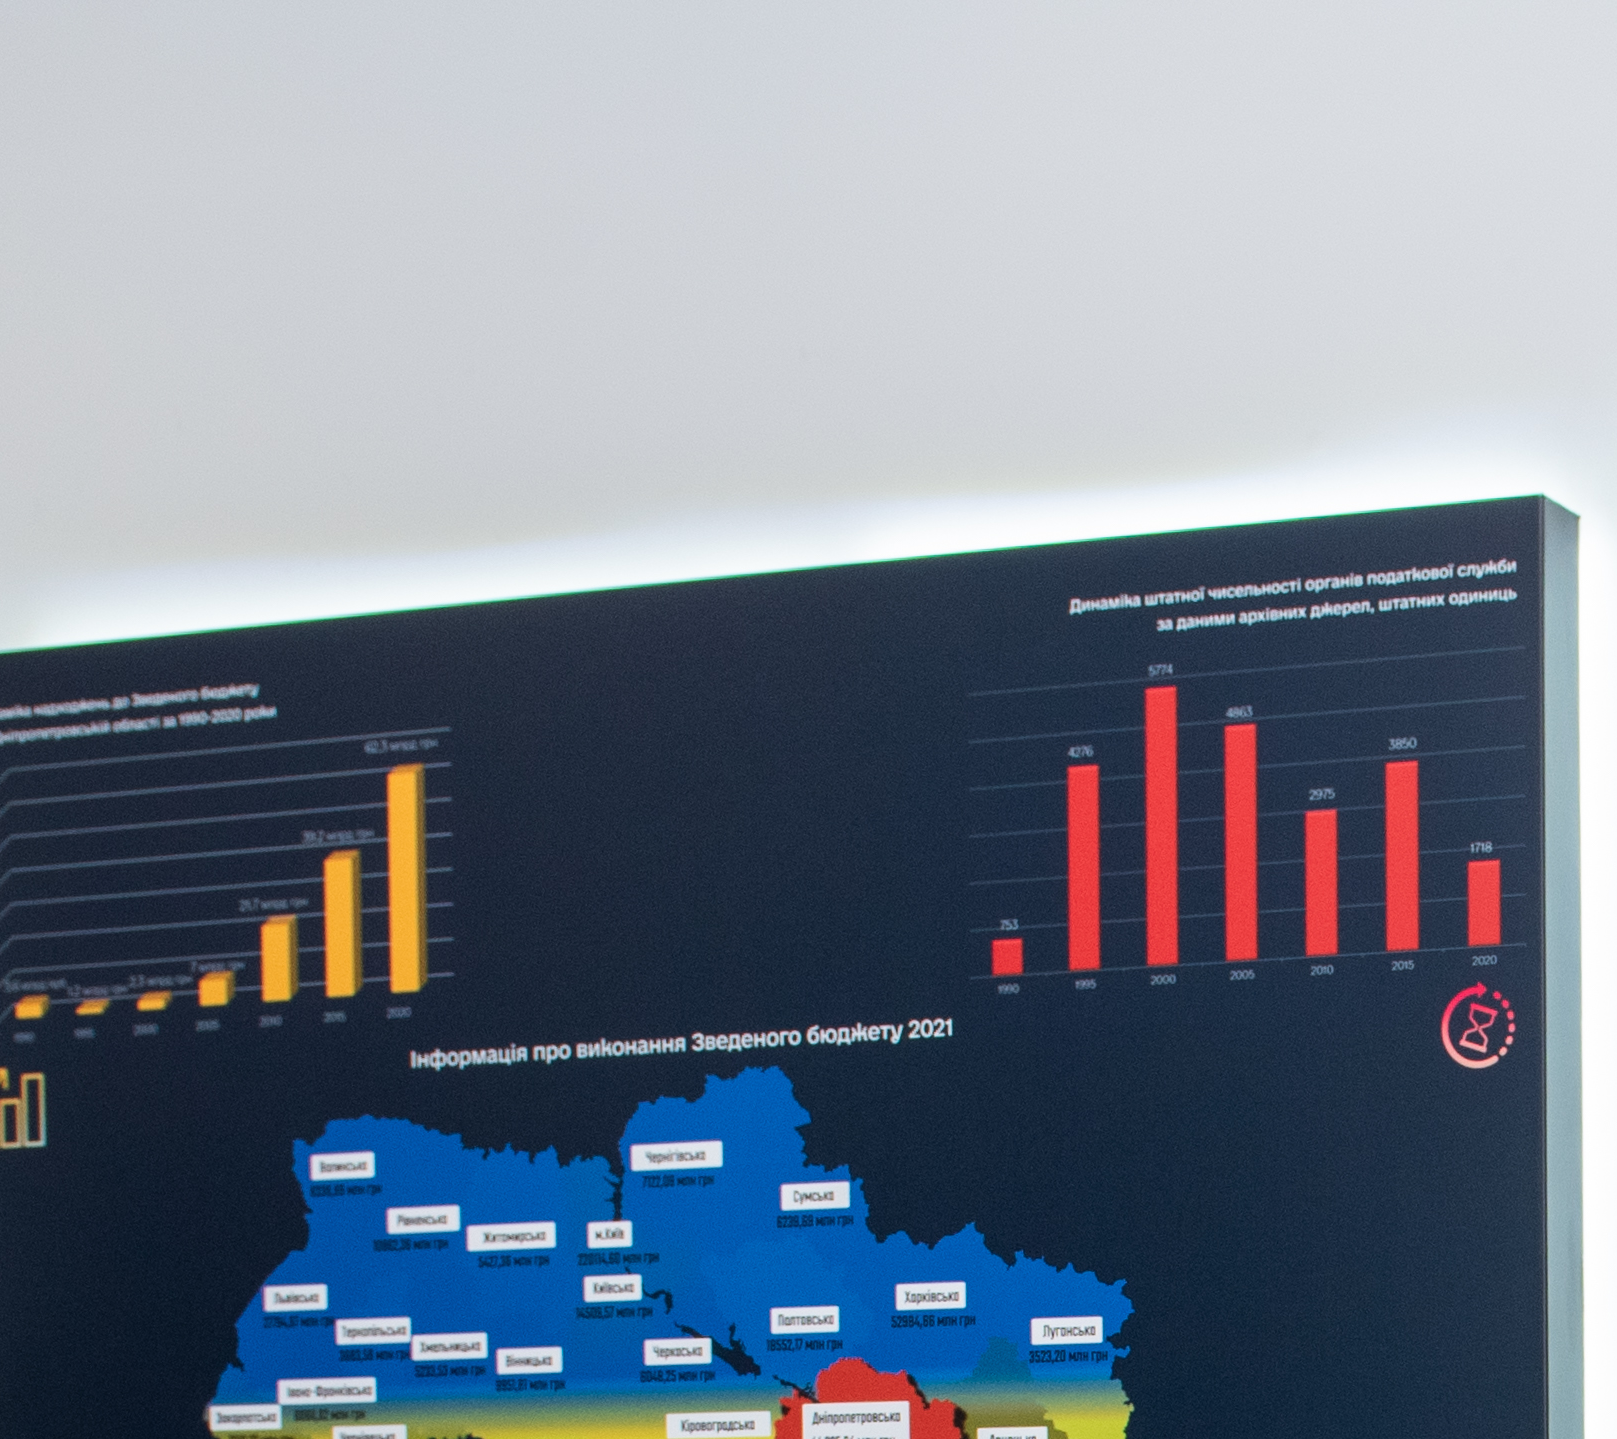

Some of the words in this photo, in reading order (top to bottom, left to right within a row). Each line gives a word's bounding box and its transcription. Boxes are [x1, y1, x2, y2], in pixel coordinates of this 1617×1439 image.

[1069, 593, 1141, 616] Динаміка
[1144, 586, 1205, 607] штатної
[1208, 577, 1301, 600] чисельності
[1305, 572, 1363, 593] органів
[1367, 563, 1454, 586] податкової
[1457, 558, 1517, 579] служби
[1157, 618, 1173, 631] за
[1176, 613, 1235, 632] даними
[1238, 607, 1306, 626] архівних
[1310, 600, 1375, 619] джерел,
[1378, 594, 1445, 612] штатних
[1448, 588, 1517, 606] одиниць
[410, 1043, 528, 1071] Інформація
[533, 1043, 571, 1065] про
[576, 1036, 686, 1059] виконання
[692, 1029, 802, 1053] Зведеного
[806, 1022, 903, 1047] бюджету
[908, 1017, 953, 1040] 2021
